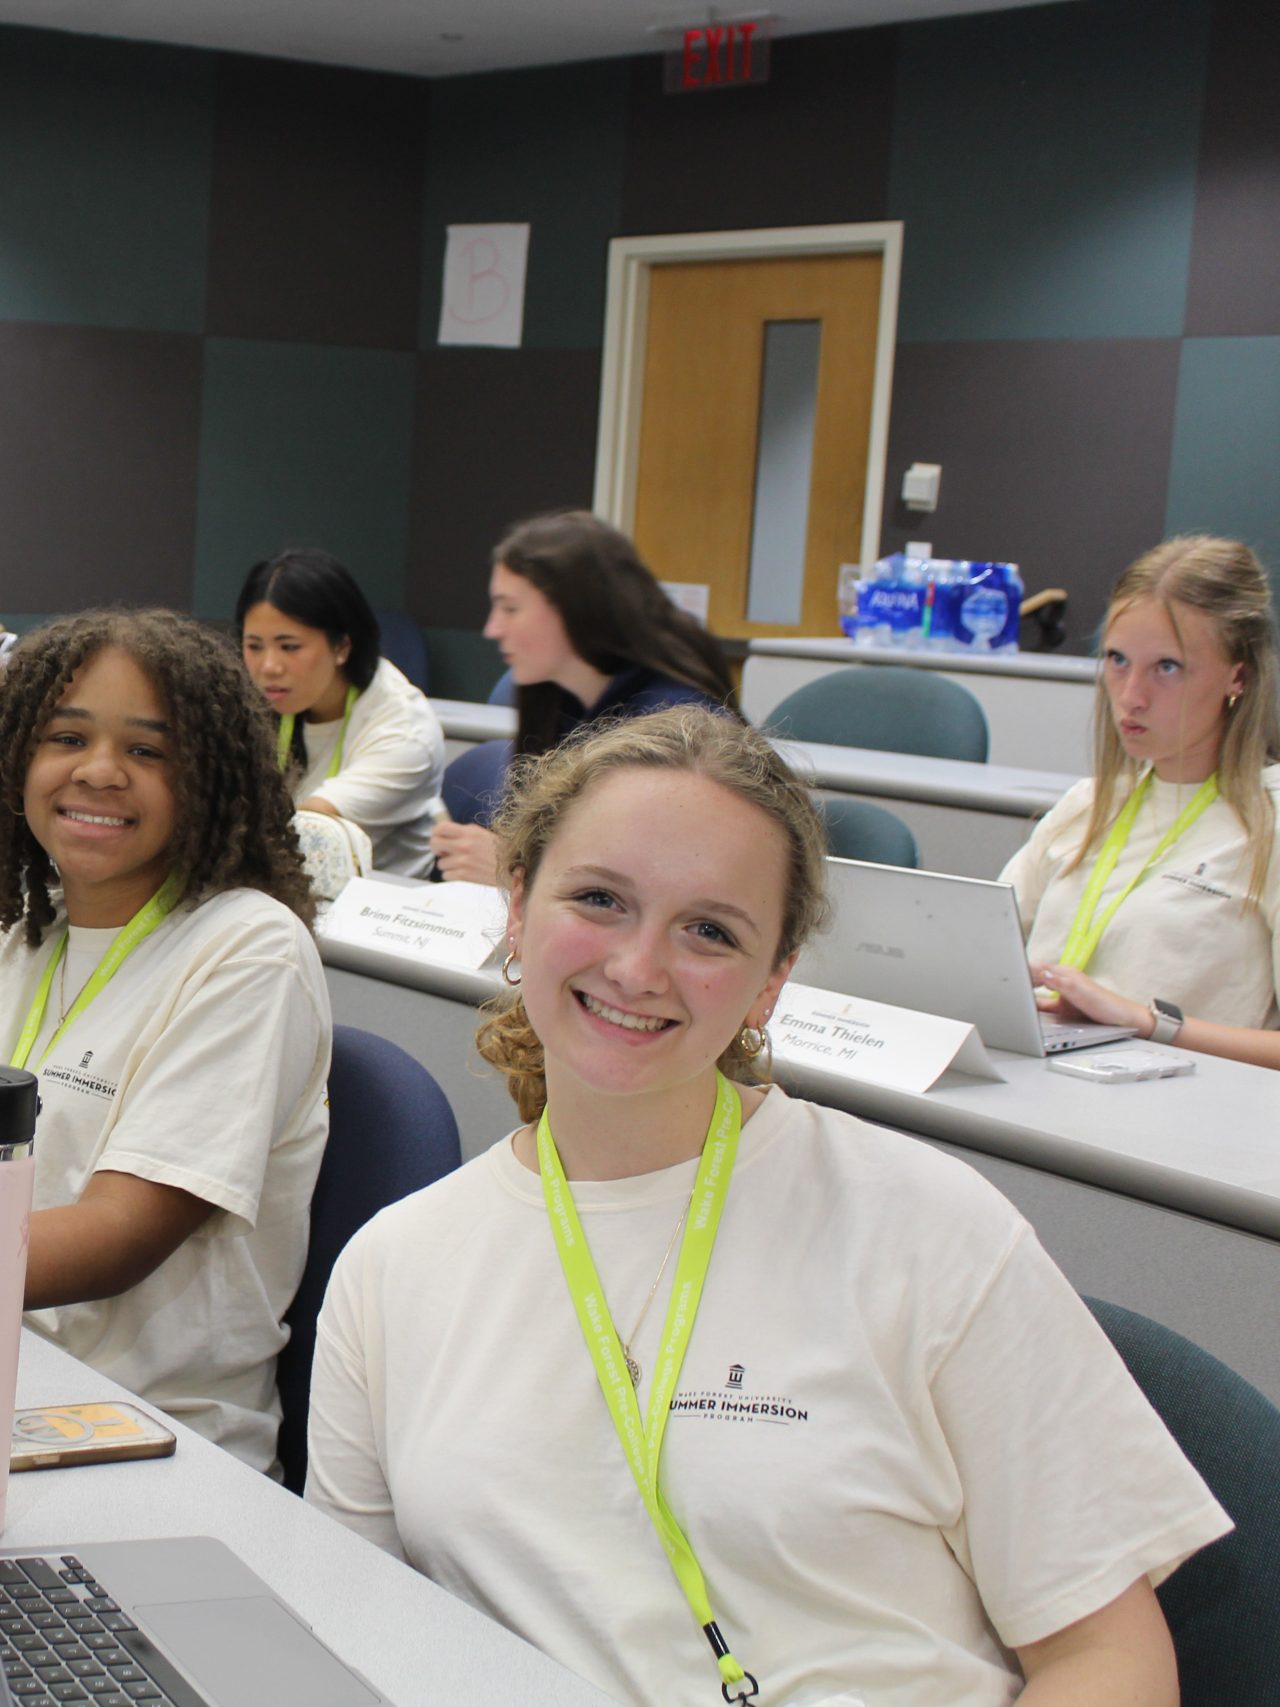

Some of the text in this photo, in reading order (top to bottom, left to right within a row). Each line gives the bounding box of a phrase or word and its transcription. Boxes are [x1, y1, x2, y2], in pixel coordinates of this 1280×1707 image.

[683, 22, 758, 88] EXIT
[448, 237, 511, 325] B
[360, 906, 392, 923] Brinn
[392, 913, 468, 940] Fitzsimmons
[780, 1013, 886, 1050] Emma Thielen
[42, 1068, 71, 1082] SUMMER
[703, 1141, 728, 1187] Forest
[549, 1178, 576, 1248] Programs
[692, 1190, 716, 1231] Wake
[583, 1291, 604, 1334] Wake
[597, 1335, 622, 1386] Forest
[664, 1280, 693, 1355] Programs
[669, 1399, 808, 1422] UMMER IMMERSION
[703, 1412, 754, 1423] PROGRAM
